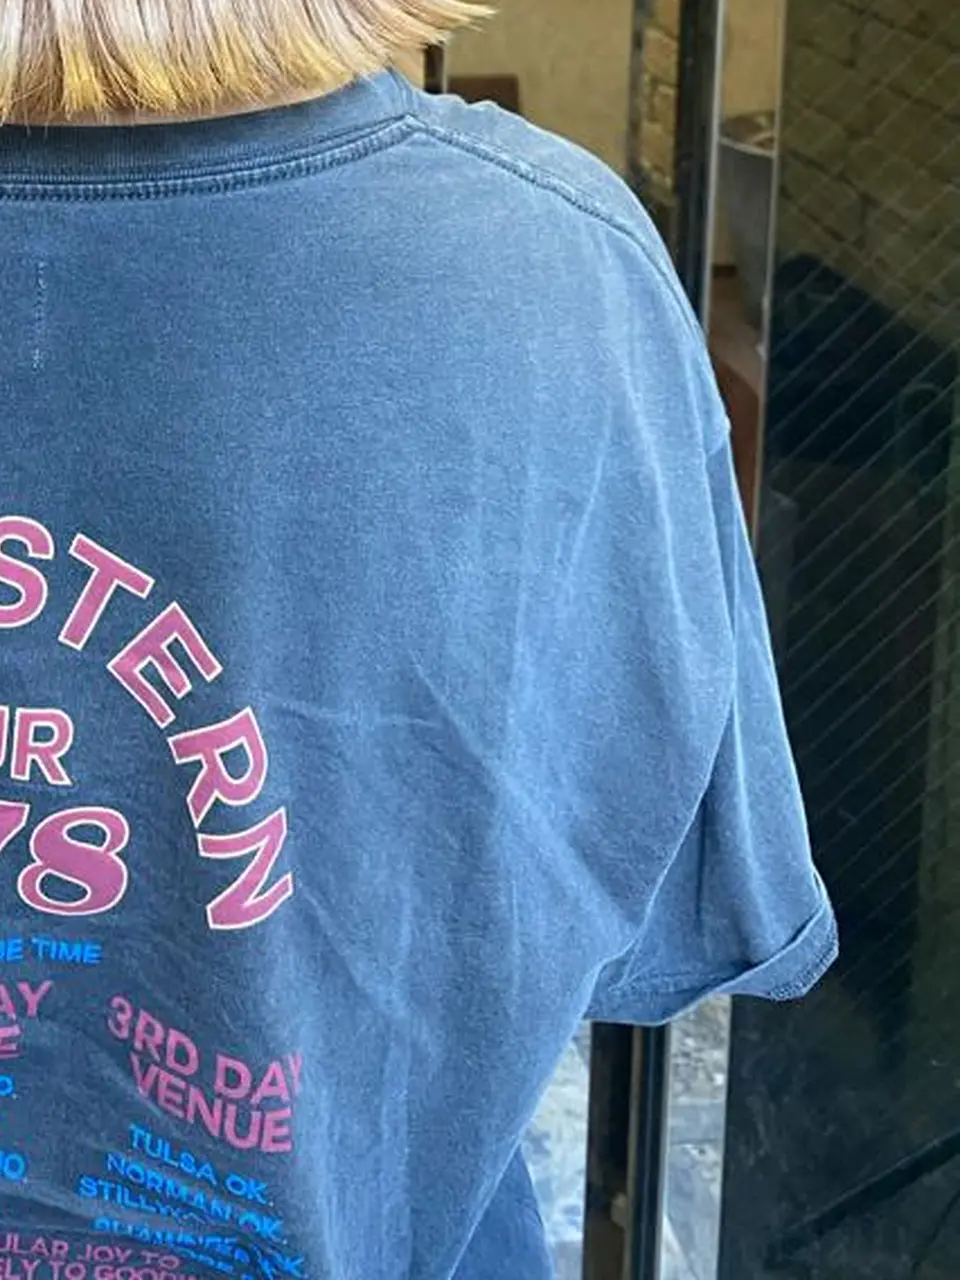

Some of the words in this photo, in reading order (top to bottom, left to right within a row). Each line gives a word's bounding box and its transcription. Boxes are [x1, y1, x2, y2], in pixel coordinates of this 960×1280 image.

[32, 935, 101, 965] TIME
[107, 994, 199, 1077] 3RD
[214, 1048, 303, 1105] DAY
[130, 1050, 293, 1153] VENUE
[129, 1124, 217, 1187] TULSA
[76, 1243, 132, 1263] JOY
